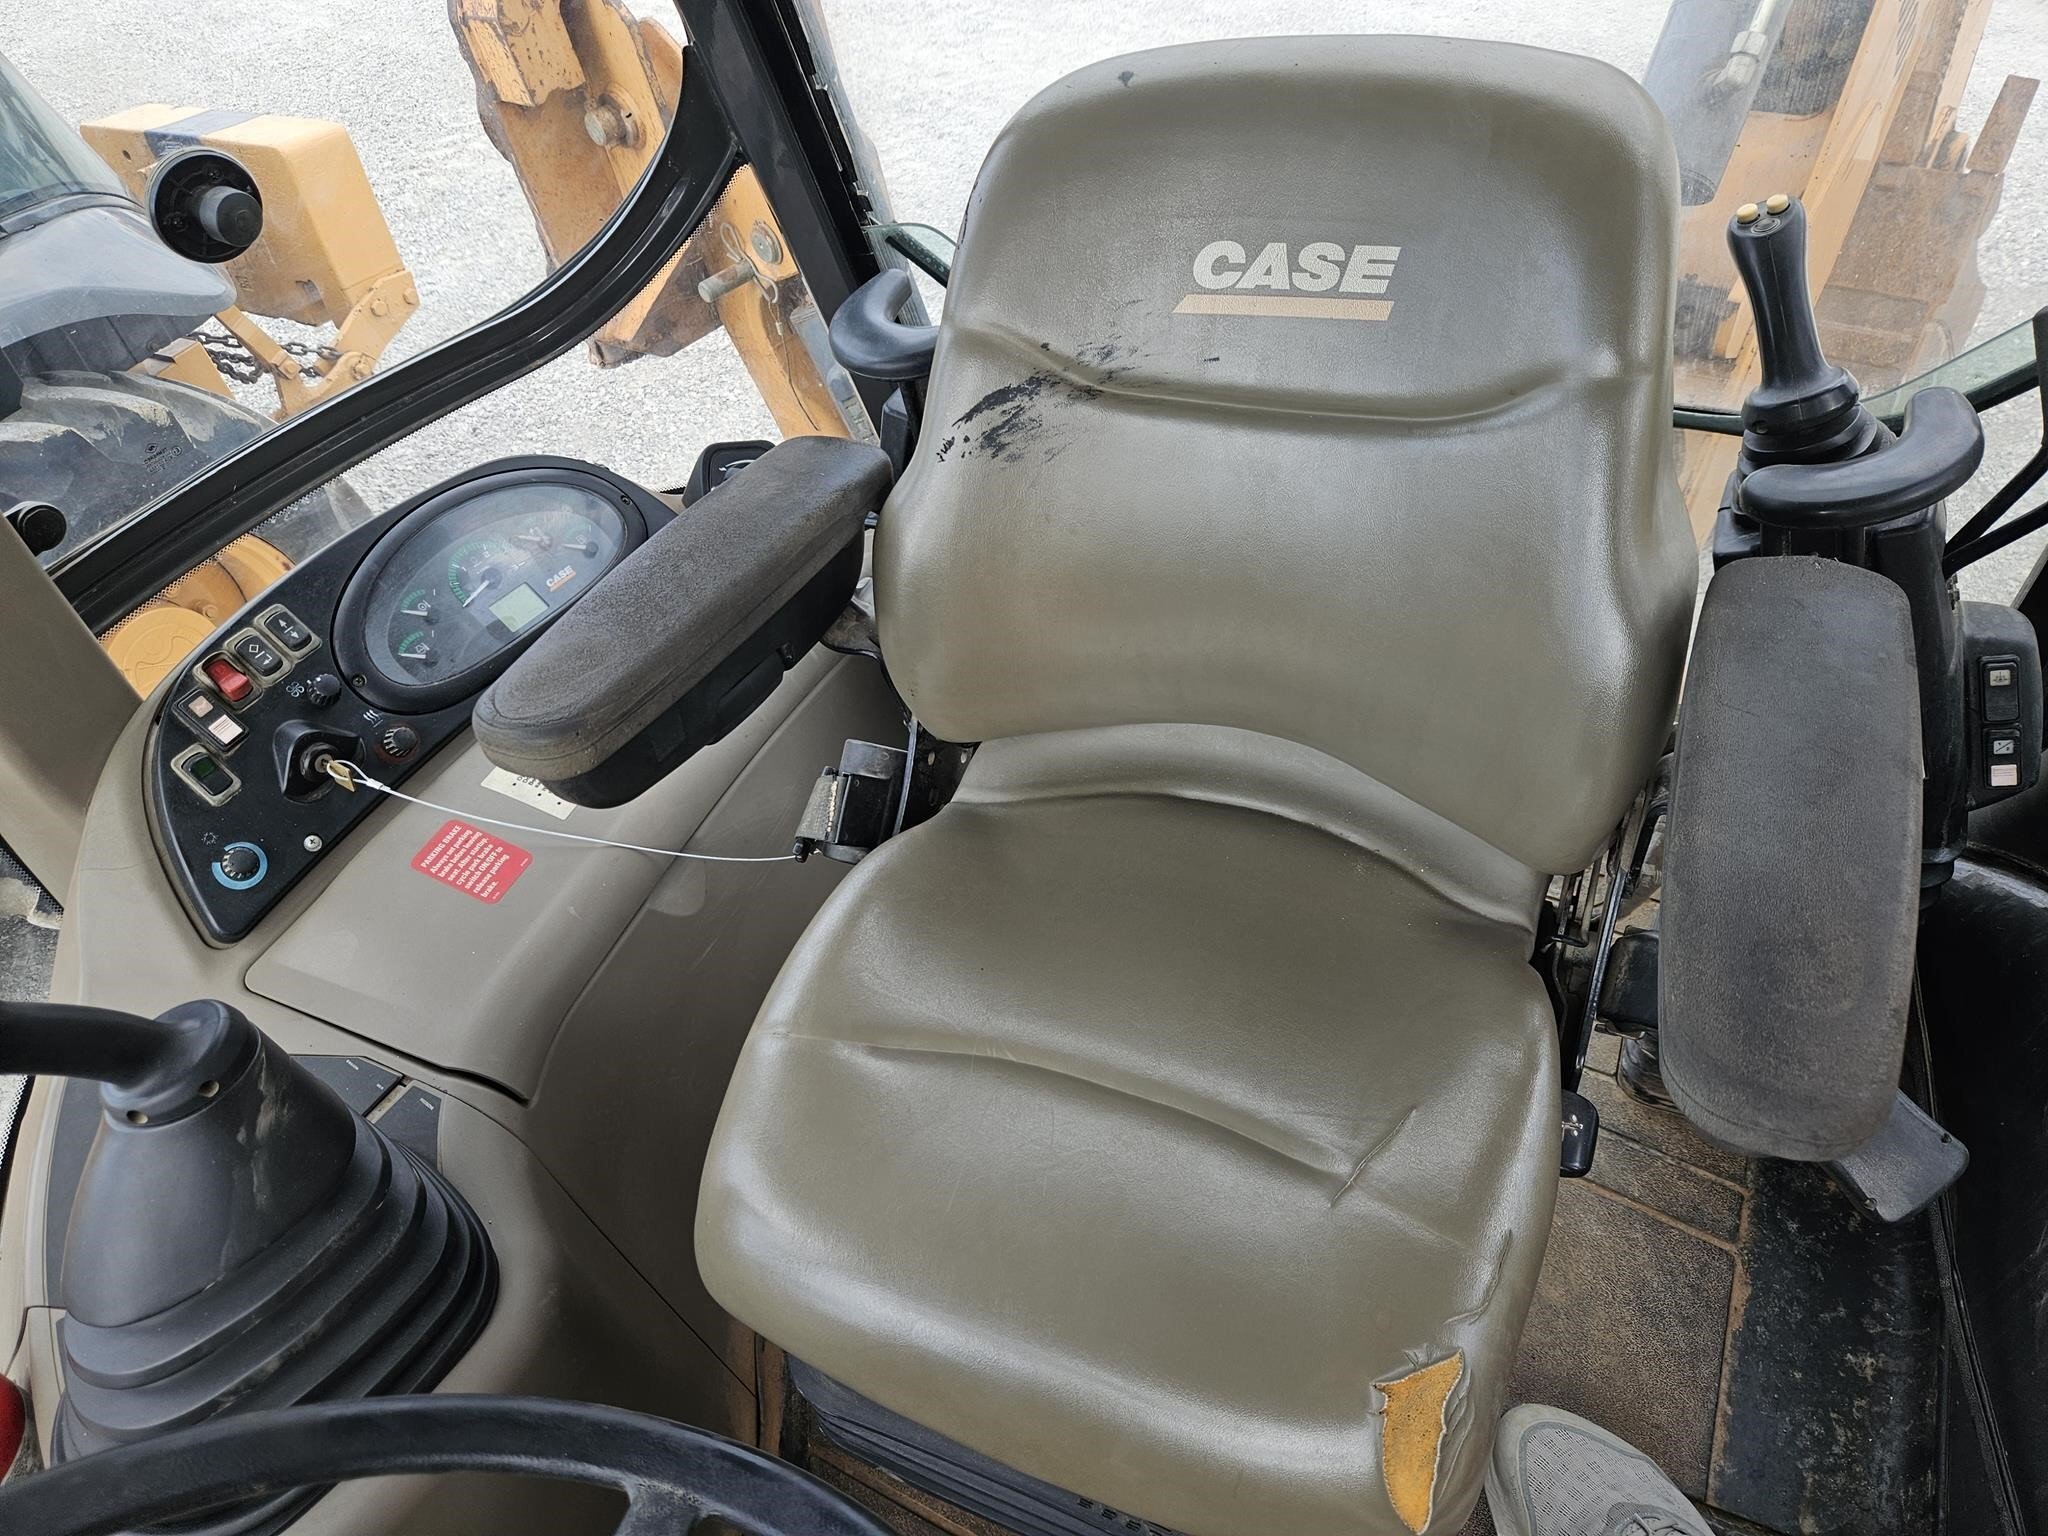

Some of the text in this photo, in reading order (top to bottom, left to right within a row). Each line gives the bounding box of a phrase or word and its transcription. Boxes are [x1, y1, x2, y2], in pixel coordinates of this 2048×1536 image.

[1193, 241, 1402, 294] CASE
[546, 565, 574, 587] CASE
[420, 825, 462, 868] PARKING BRAKE
[430, 830, 473, 873] Always set parking
[437, 863, 454, 877] brake
[449, 848, 467, 864] before
[458, 855, 472, 869] After
[456, 844, 493, 885] cycle park brake
[465, 871, 482, 889] switch
[473, 873, 492, 893] release
[489, 854, 510, 875] parking
[480, 881, 498, 897] brake.
